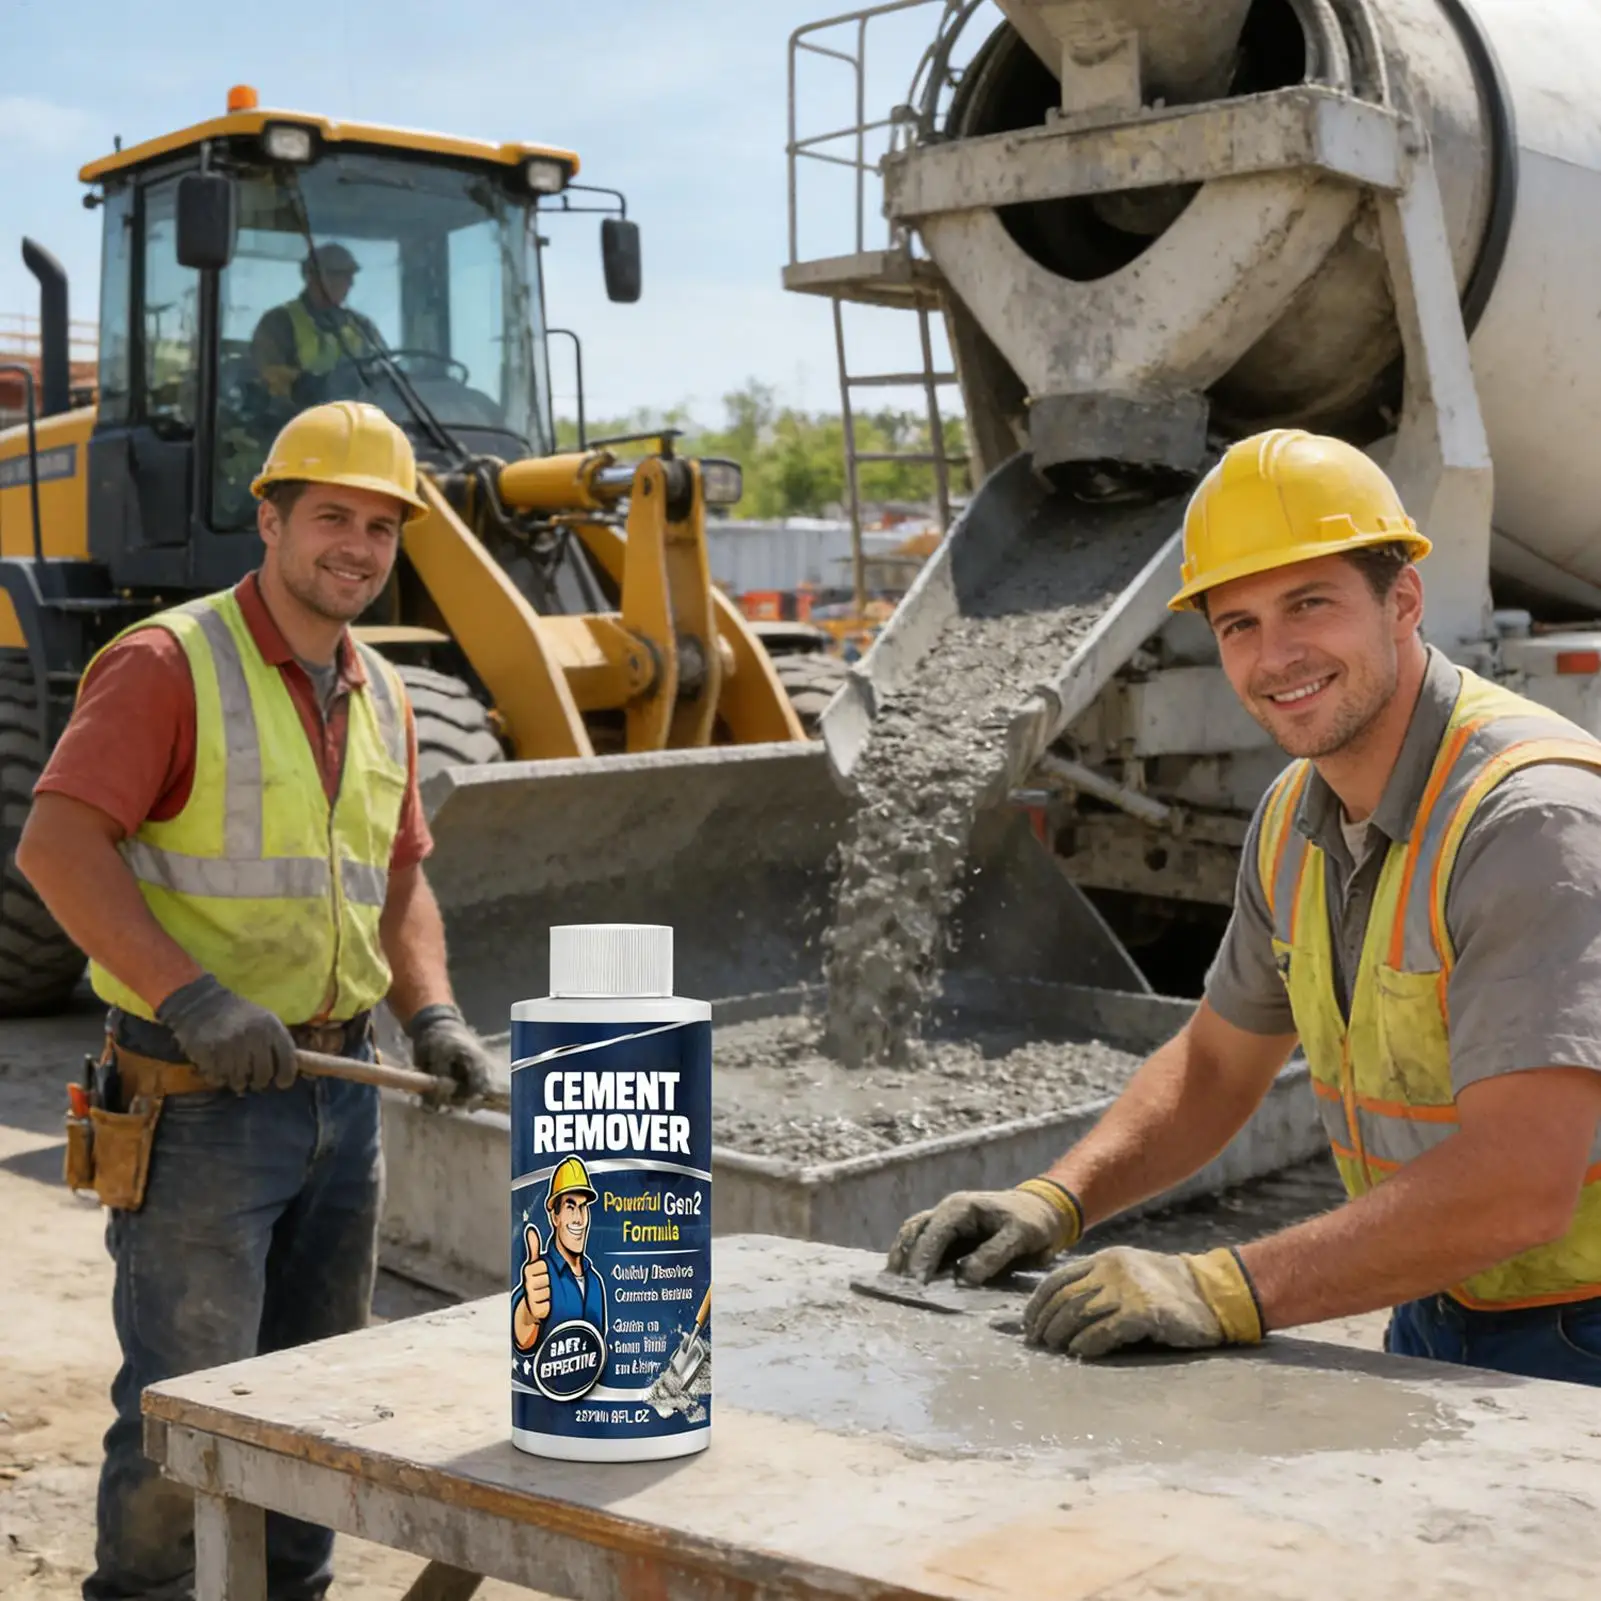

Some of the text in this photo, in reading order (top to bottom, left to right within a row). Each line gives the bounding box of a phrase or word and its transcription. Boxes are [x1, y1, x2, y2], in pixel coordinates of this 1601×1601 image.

[544, 1071, 680, 1111] CEMENT
[533, 1113, 691, 1155] REMOVER
[664, 1191, 702, 1216] Gen2
